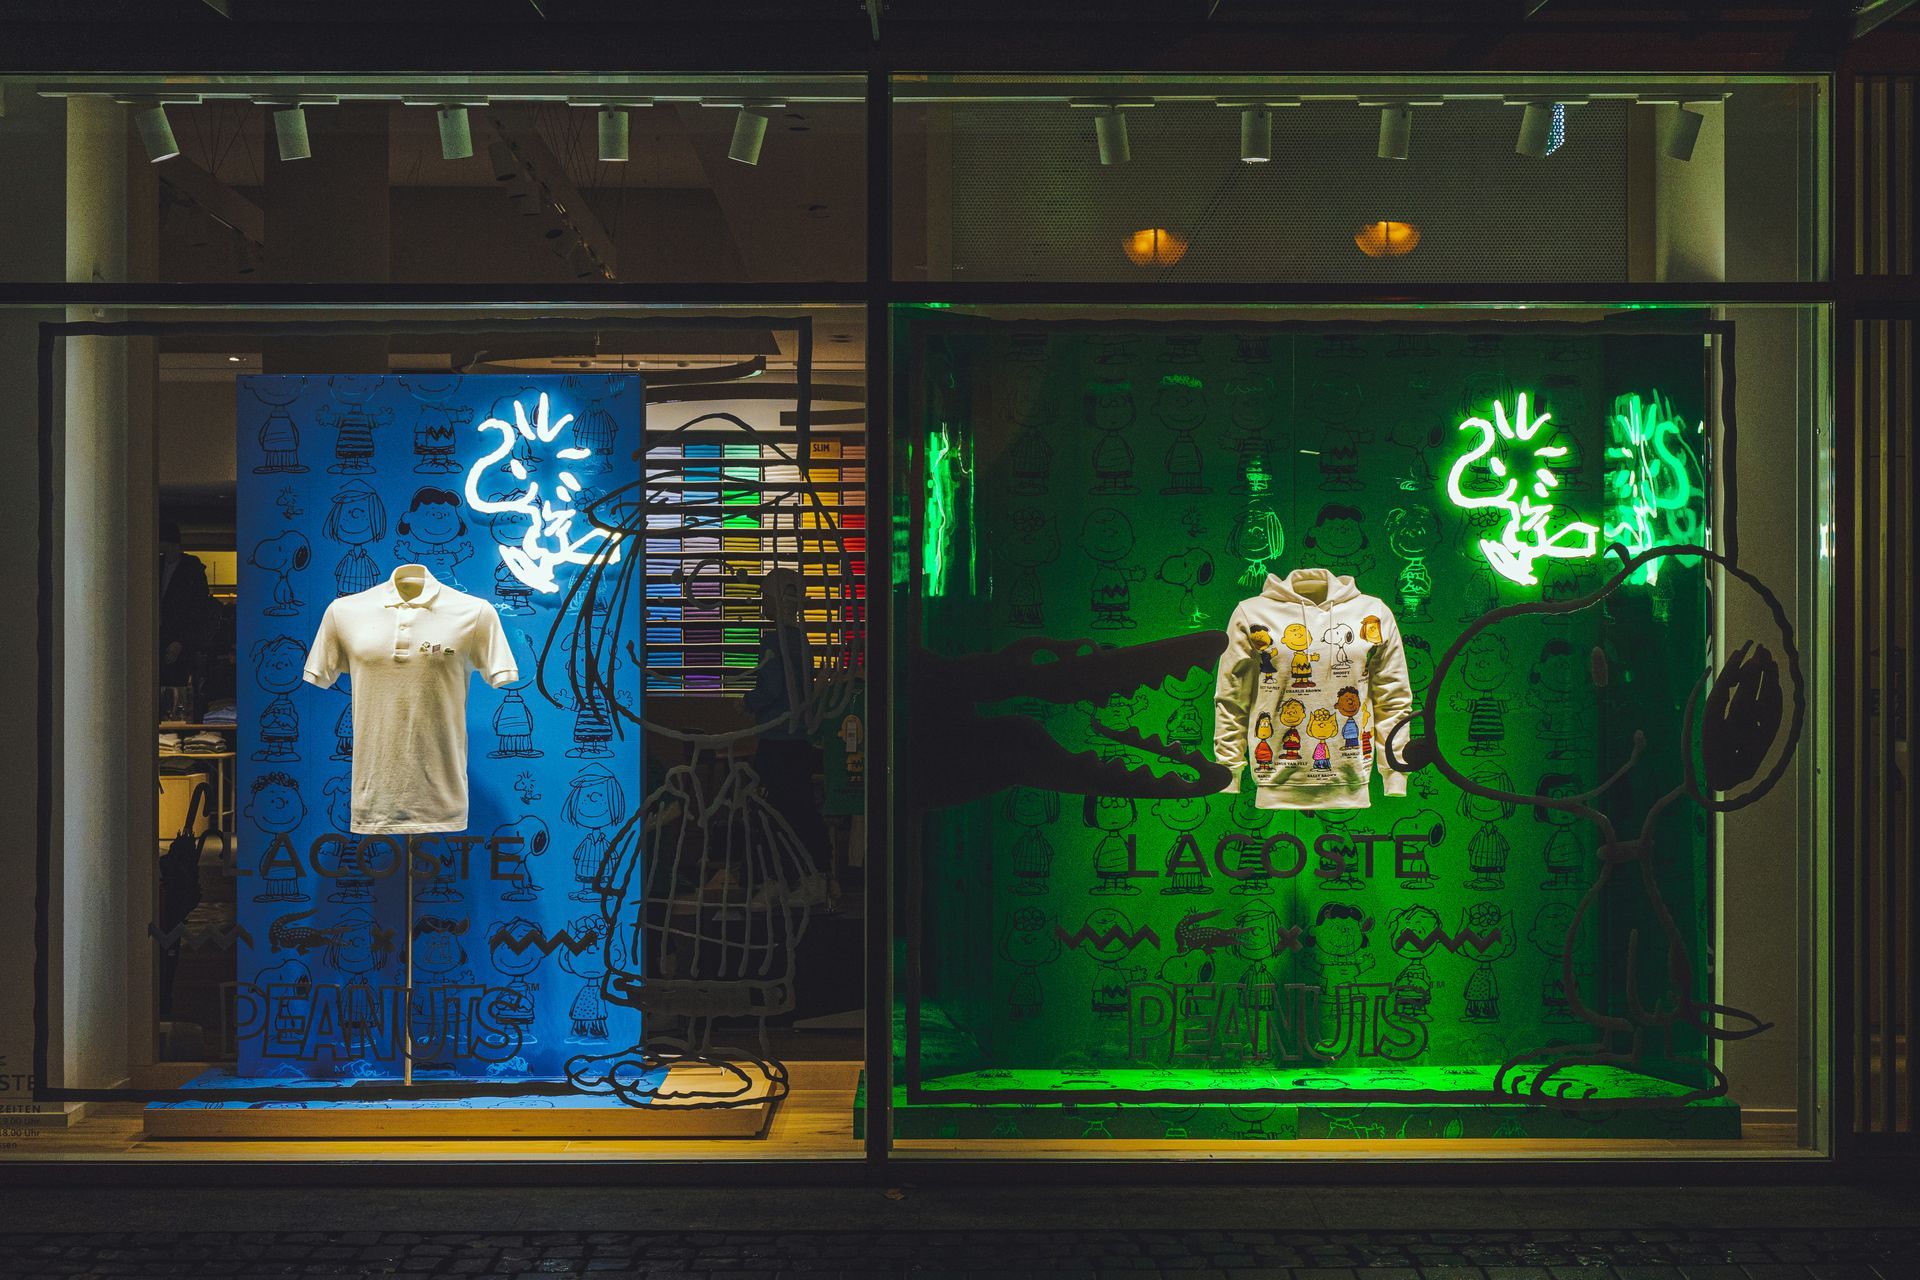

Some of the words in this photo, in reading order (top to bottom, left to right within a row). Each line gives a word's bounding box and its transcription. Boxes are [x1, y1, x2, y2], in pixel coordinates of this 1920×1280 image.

[812, 443, 830, 452] SLIM
[222, 833, 525, 880] LACOSTE
[1127, 833, 1429, 879] LACOSTE
[222, 984, 524, 1062] PEANUTS
[1126, 982, 1430, 1061] PEANUTS
[24, 1128, 40, 1137] Uhr
